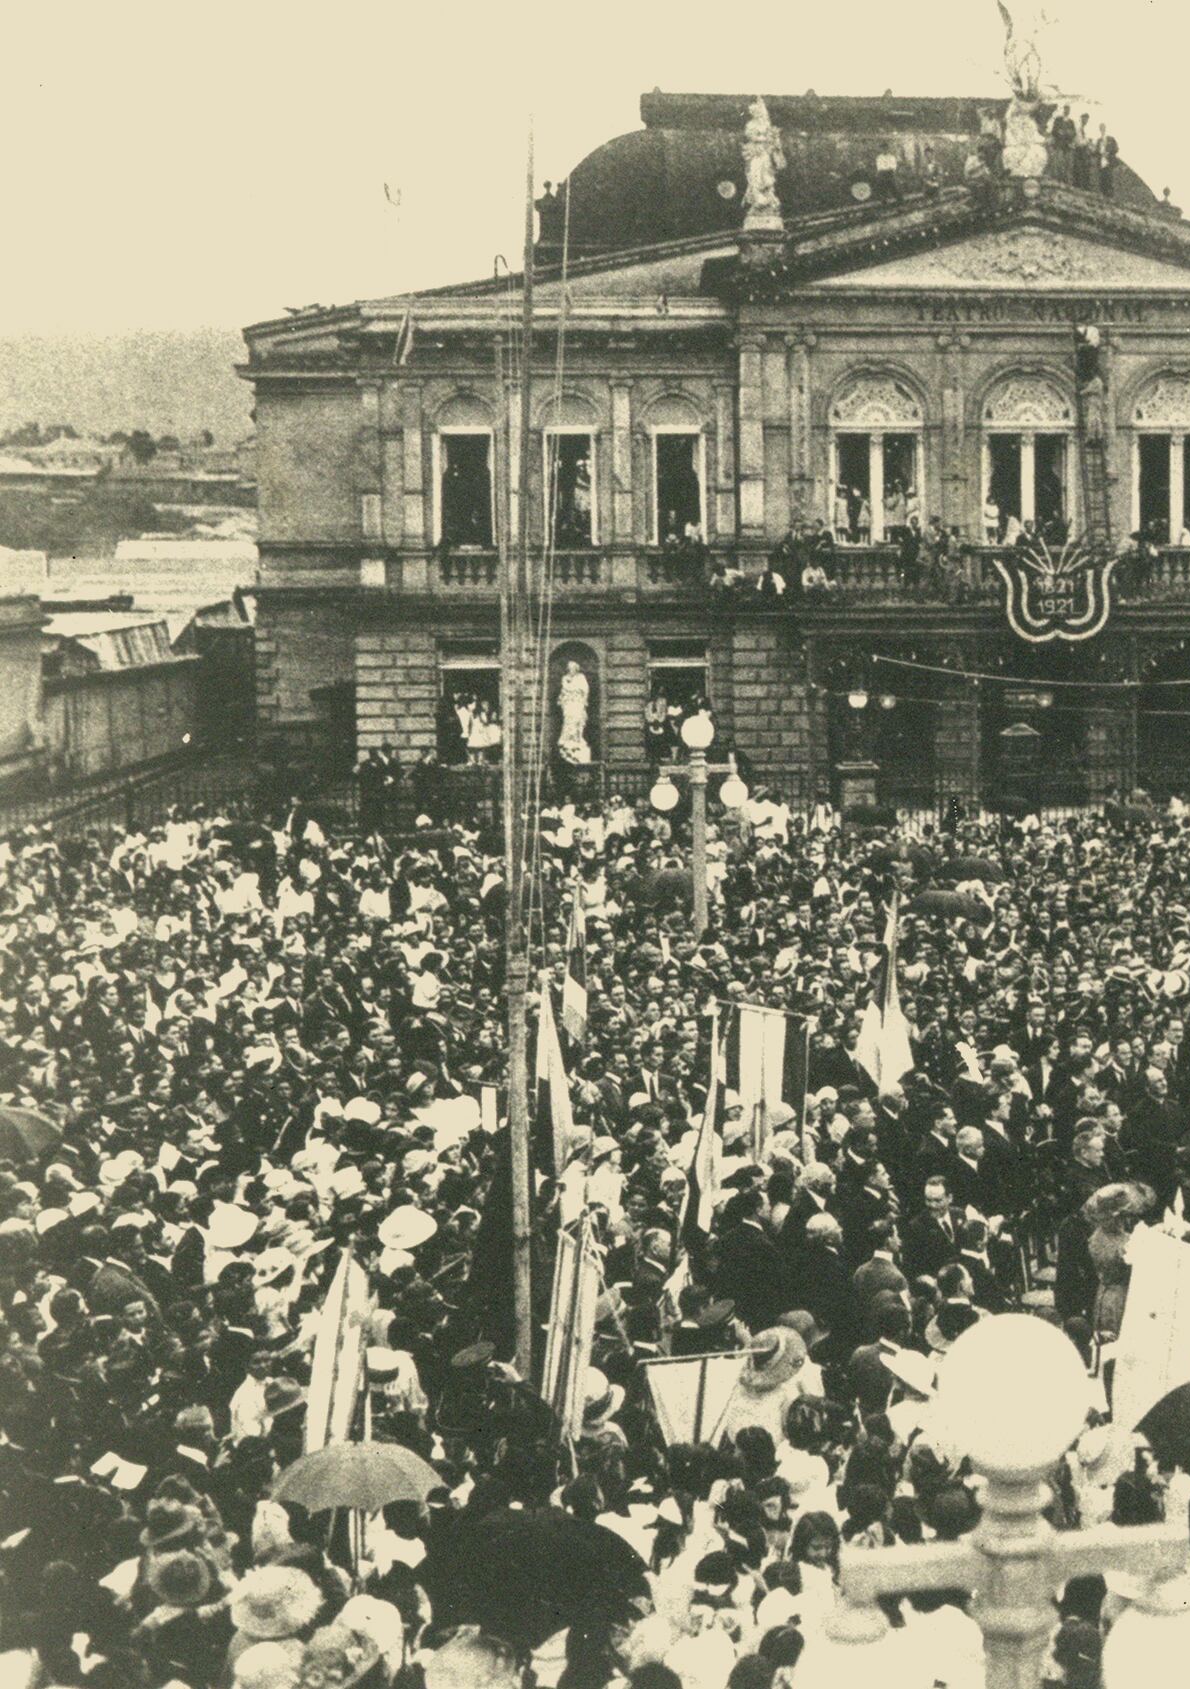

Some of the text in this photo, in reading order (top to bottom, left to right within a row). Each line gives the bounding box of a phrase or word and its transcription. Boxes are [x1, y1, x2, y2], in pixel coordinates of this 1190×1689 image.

[914, 302, 1006, 321] TEATRO
[1038, 577, 1075, 594] 1821
[1038, 598, 1075, 615] 1921
